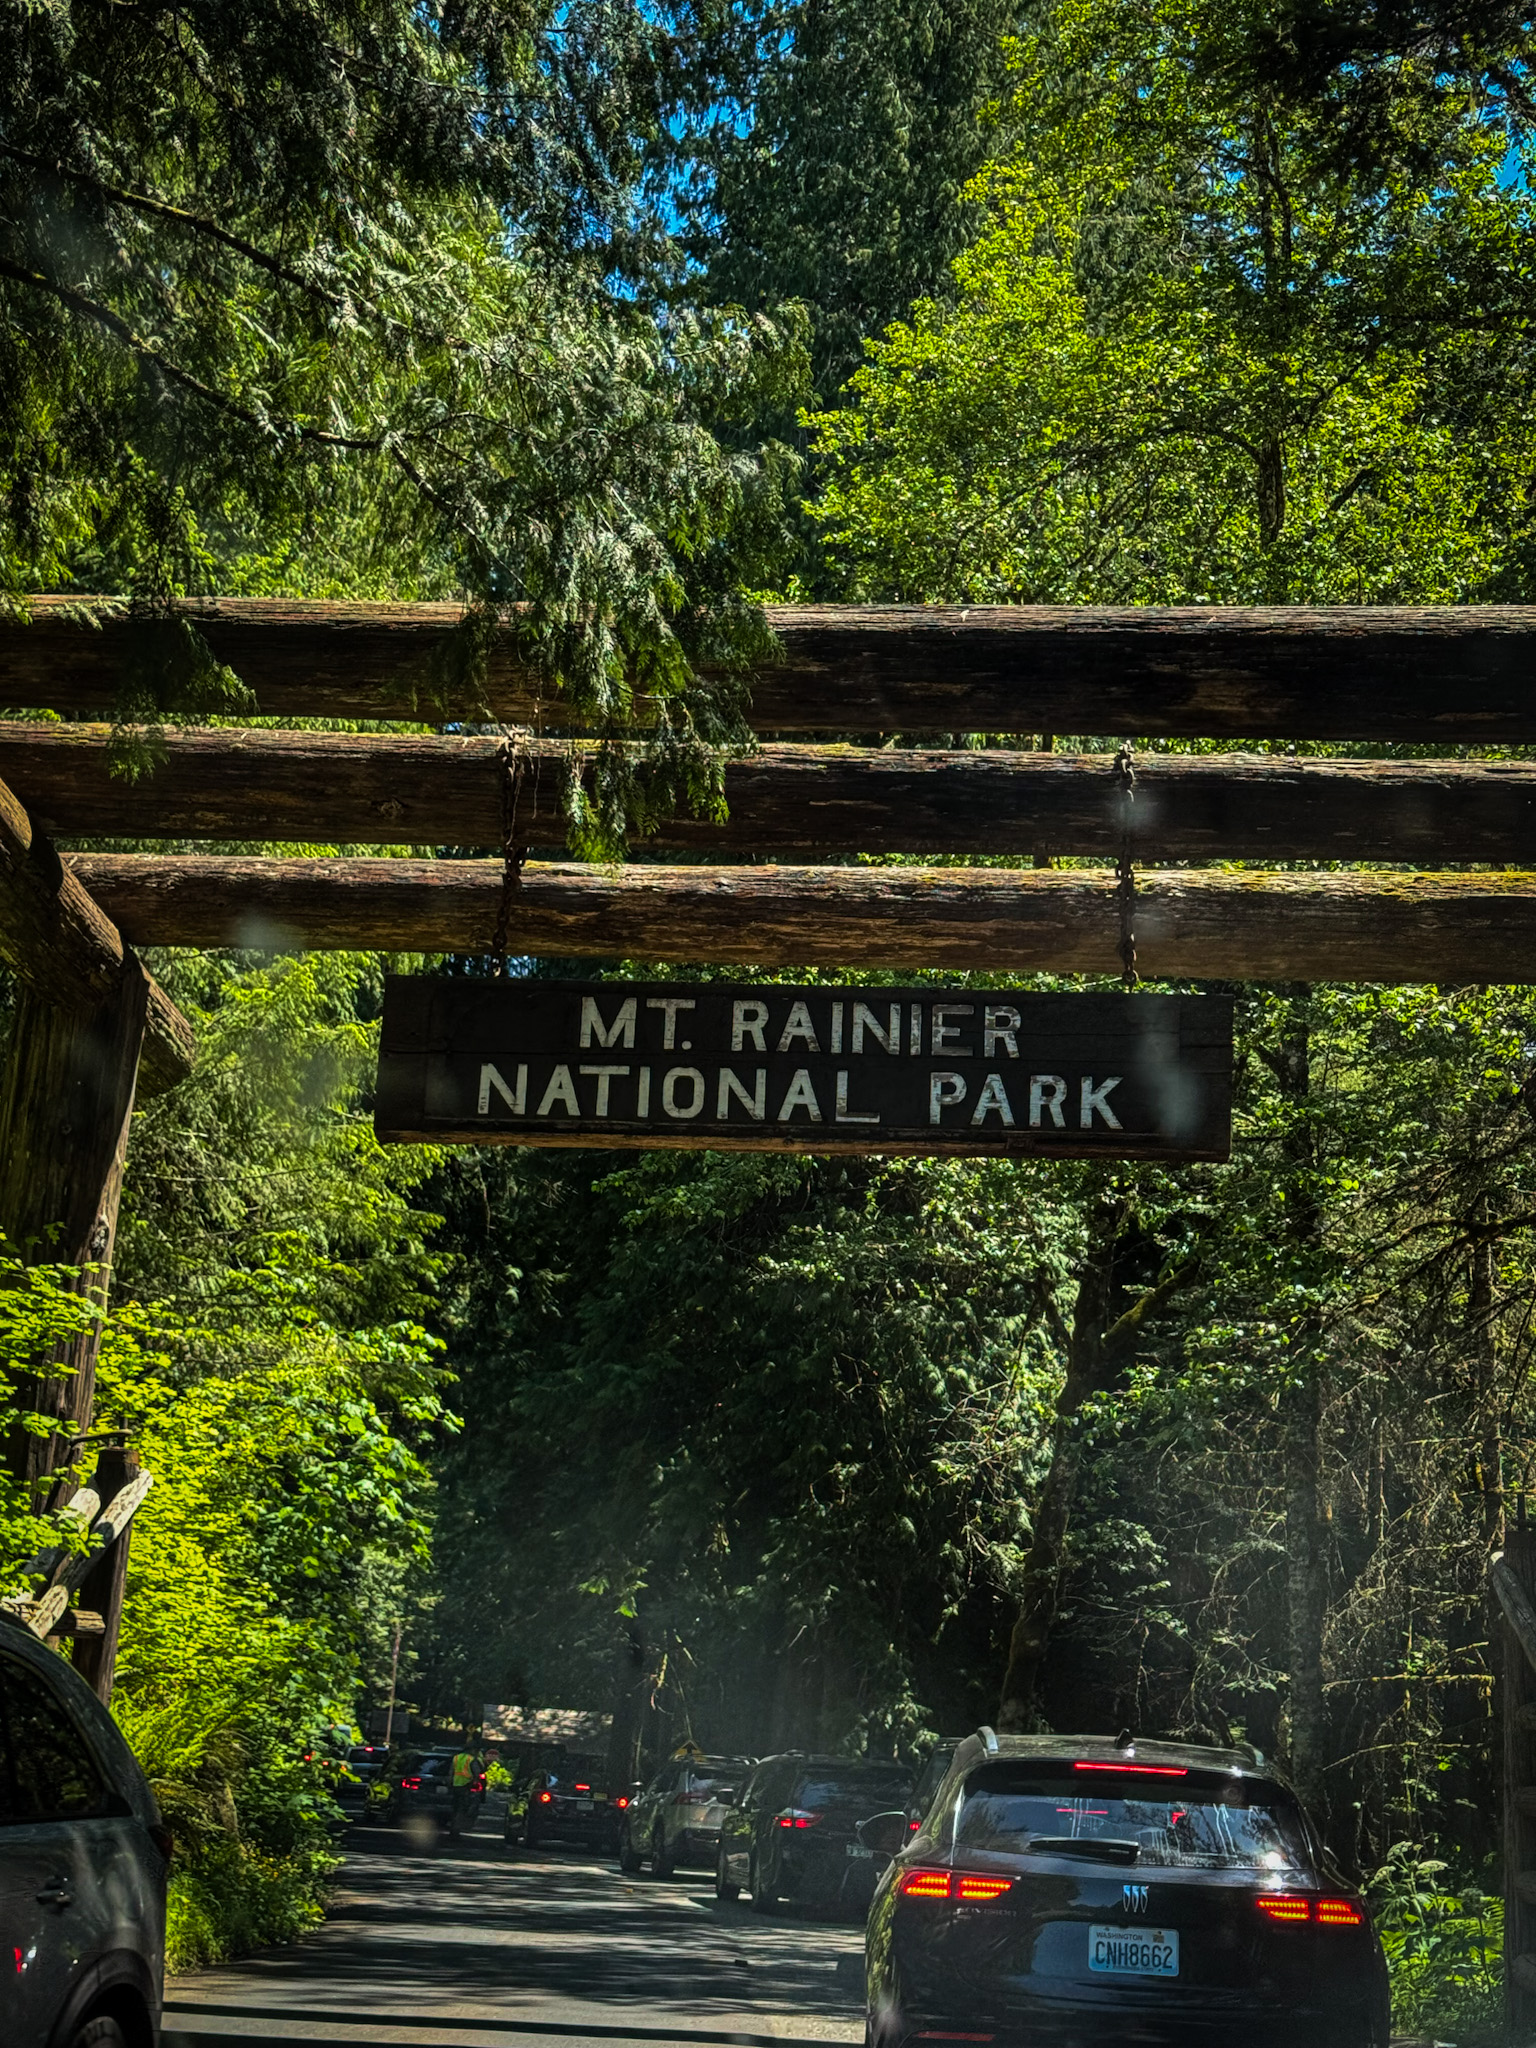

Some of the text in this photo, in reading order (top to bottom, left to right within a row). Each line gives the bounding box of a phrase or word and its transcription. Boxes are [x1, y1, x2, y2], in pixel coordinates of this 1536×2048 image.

[579, 996, 1022, 1058] MT. RAINIER
[477, 1063, 1124, 1130] NATIONAL PARK
[1095, 1941, 1173, 1969] CNH8662
[1096, 1931, 1143, 1942] WASHINGTON
